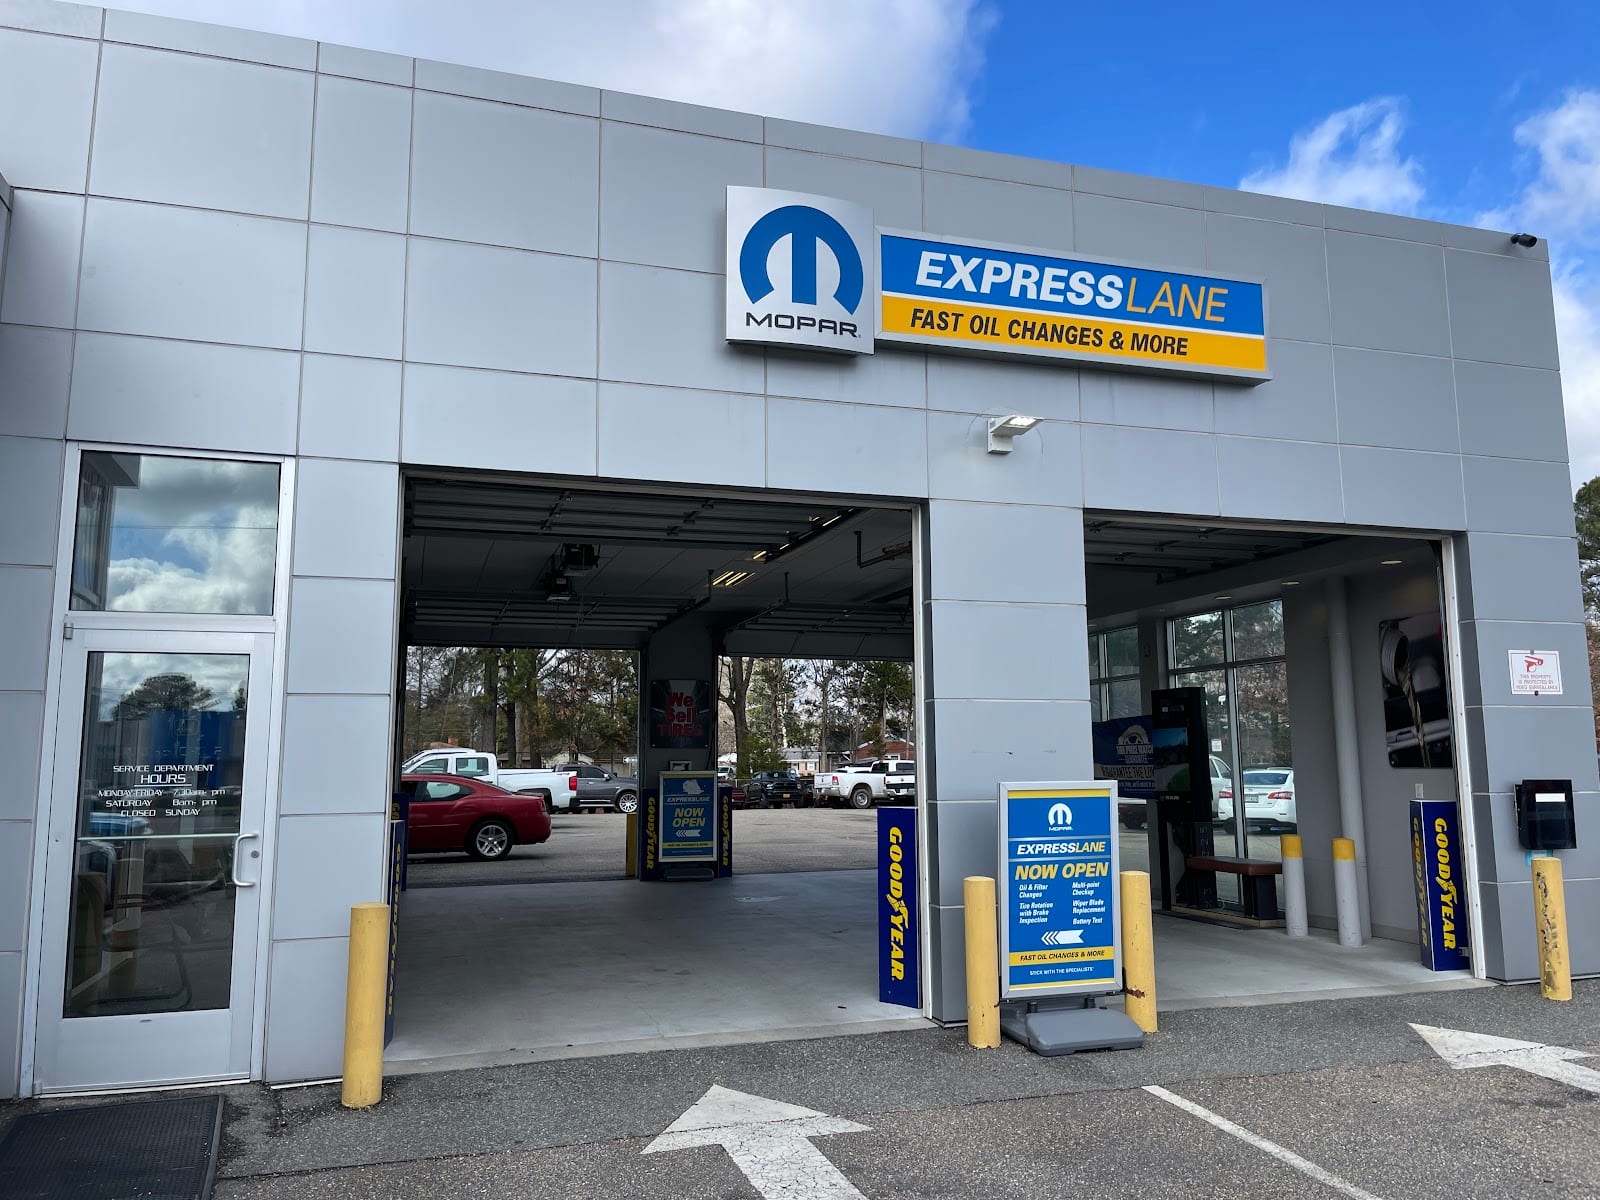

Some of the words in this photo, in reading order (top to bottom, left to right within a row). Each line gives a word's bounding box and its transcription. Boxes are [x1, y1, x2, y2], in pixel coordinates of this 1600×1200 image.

[746, 312, 859, 338] MOPAR
[910, 308, 963, 332] FAST
[969, 315, 1001, 337] OIL
[1008, 319, 1104, 348] CHANGES
[1109, 330, 1124, 350] &
[1130, 333, 1188, 356] MORE
[667, 692, 694, 706] We
[664, 707, 697, 723] Sell
[657, 724, 703, 737] TIRES
[113, 765, 150, 773] SERVICE
[154, 764, 214, 772] DEPARTMENT
[140, 774, 186, 784] HOURS
[105, 799, 153, 807] SATURDAY
[120, 809, 156, 817] CLOSED
[165, 808, 200, 816] SUNDAY
[674, 807, 705, 817] NOW
[672, 817, 706, 828] OPEN
[646, 797, 657, 870] GOODYEAR
[1015, 864, 1059, 880] NOW
[1062, 862, 1110, 879] OPEN
[1434, 817, 1457, 950] GOODYEAR
[1019, 891, 1042, 899] Changes
[1072, 889, 1095, 897] Checkup
[886, 826, 908, 982] GOODYEAR
[1019, 902, 1030, 910] Tire
[1073, 900, 1088, 908] Wiper
[1032, 909, 1049, 917] Brake
[1073, 906, 1106, 915] Replacement
[1019, 917, 1047, 925] Inspection
